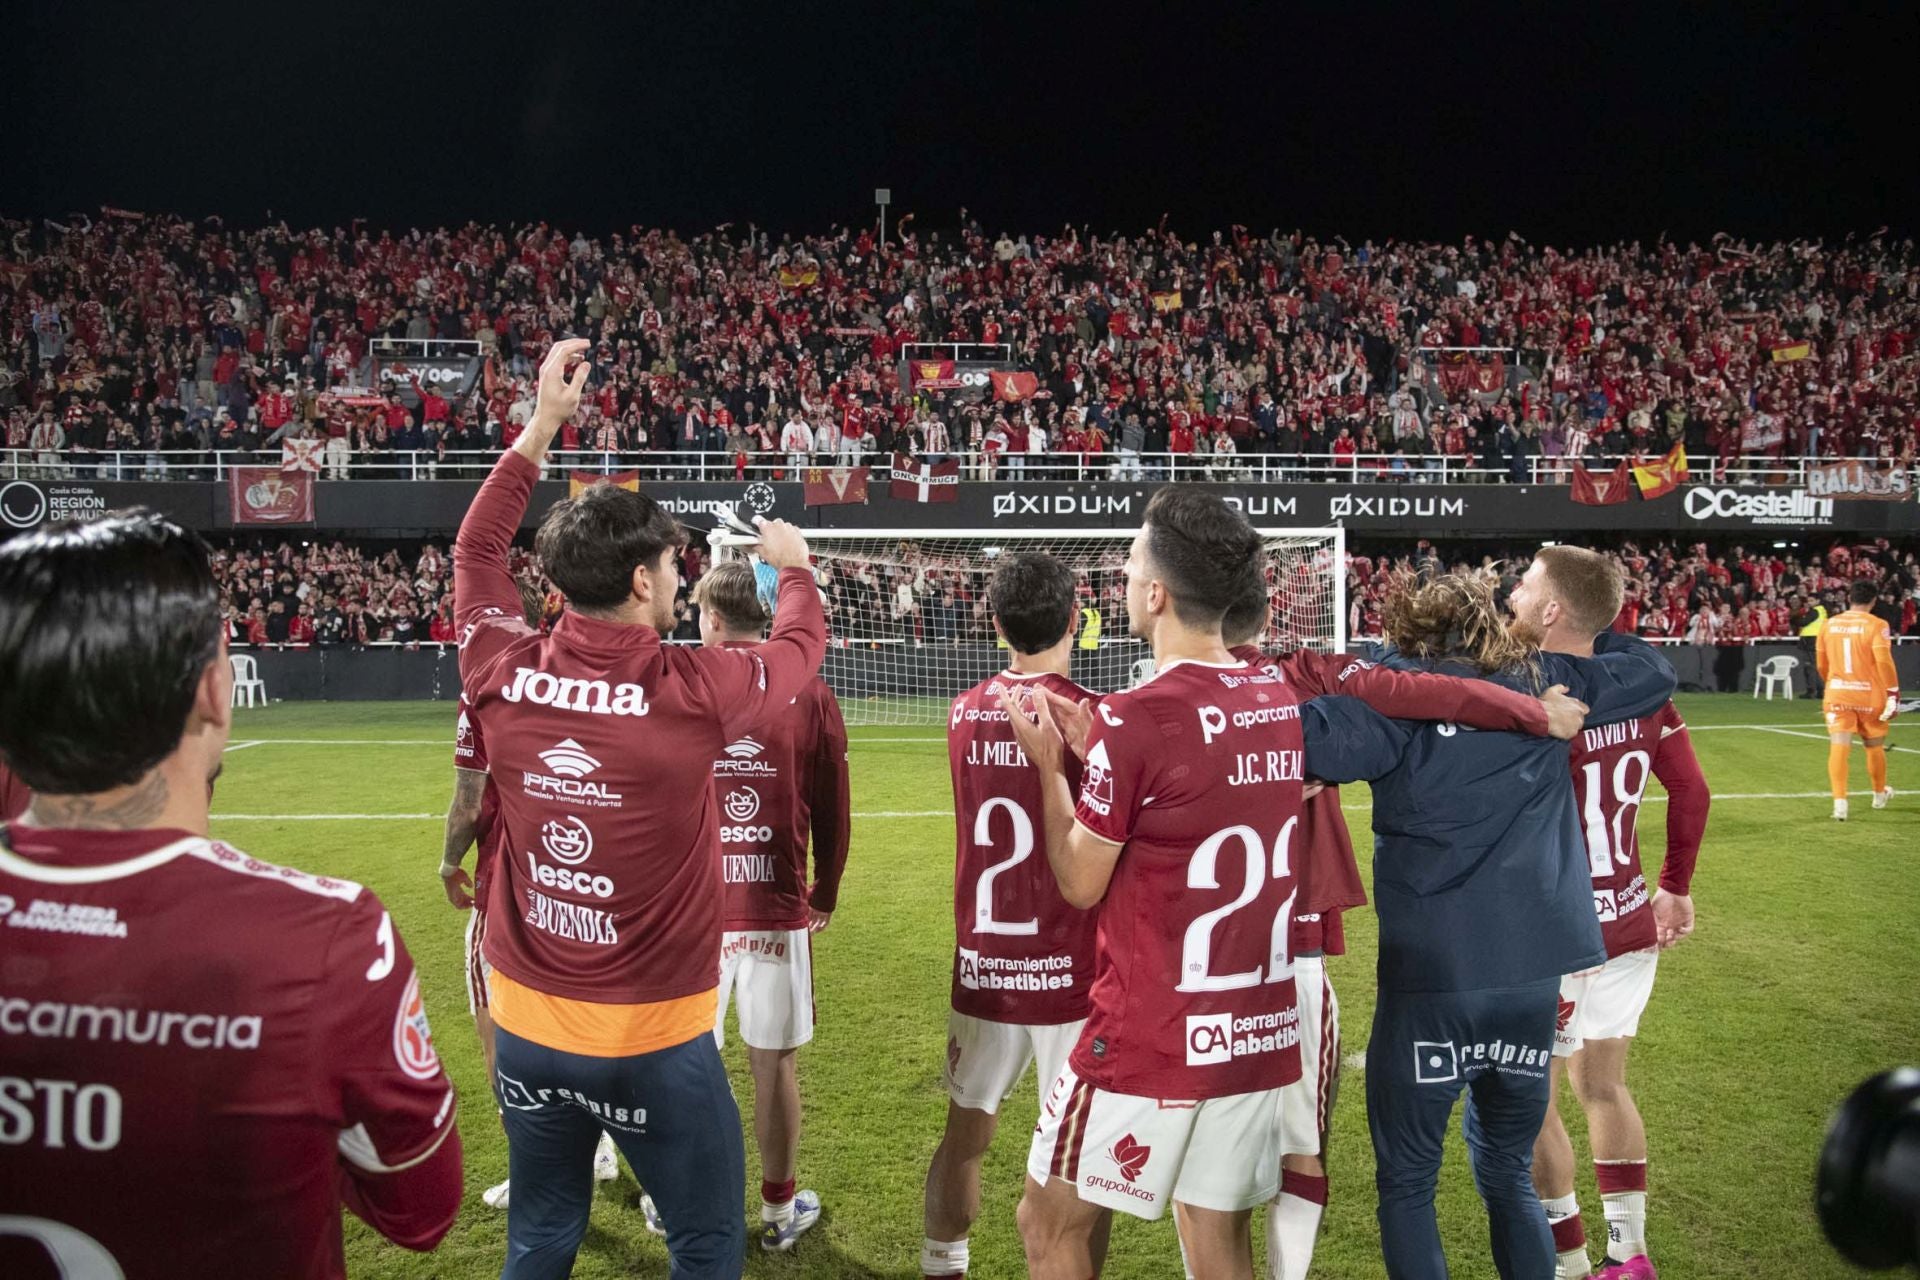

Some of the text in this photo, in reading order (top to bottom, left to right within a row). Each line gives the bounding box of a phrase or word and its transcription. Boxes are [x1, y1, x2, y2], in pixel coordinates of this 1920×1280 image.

[893, 471, 917, 480] ONLY
[49, 495, 105, 509] REGIÓN
[1223, 497, 1297, 515] DUM
[1714, 488, 1834, 517] Castellini
[1842, 637, 1853, 674] 1
[501, 667, 650, 717] Joma
[1584, 722, 1626, 752] DAVID
[713, 760, 777, 772] PROAL
[966, 740, 980, 765] J.
[1266, 750, 1304, 782] REAL
[555, 793, 585, 806] Ventanas
[593, 799, 622, 808] Puertas
[1582, 750, 1651, 878] 18
[720, 825, 773, 843] esco
[526, 851, 615, 898] lesco
[723, 854, 776, 883] UENDIA
[973, 797, 1039, 936] 2
[978, 955, 1073, 972] cerramientos
[979, 971, 1074, 992] abatibles
[0, 996, 263, 1049] camurcia
[1190, 1024, 1229, 1054] CA
[1461, 1039, 1550, 1068] redpiso
[1086, 1175, 1156, 1202] grupolucas
